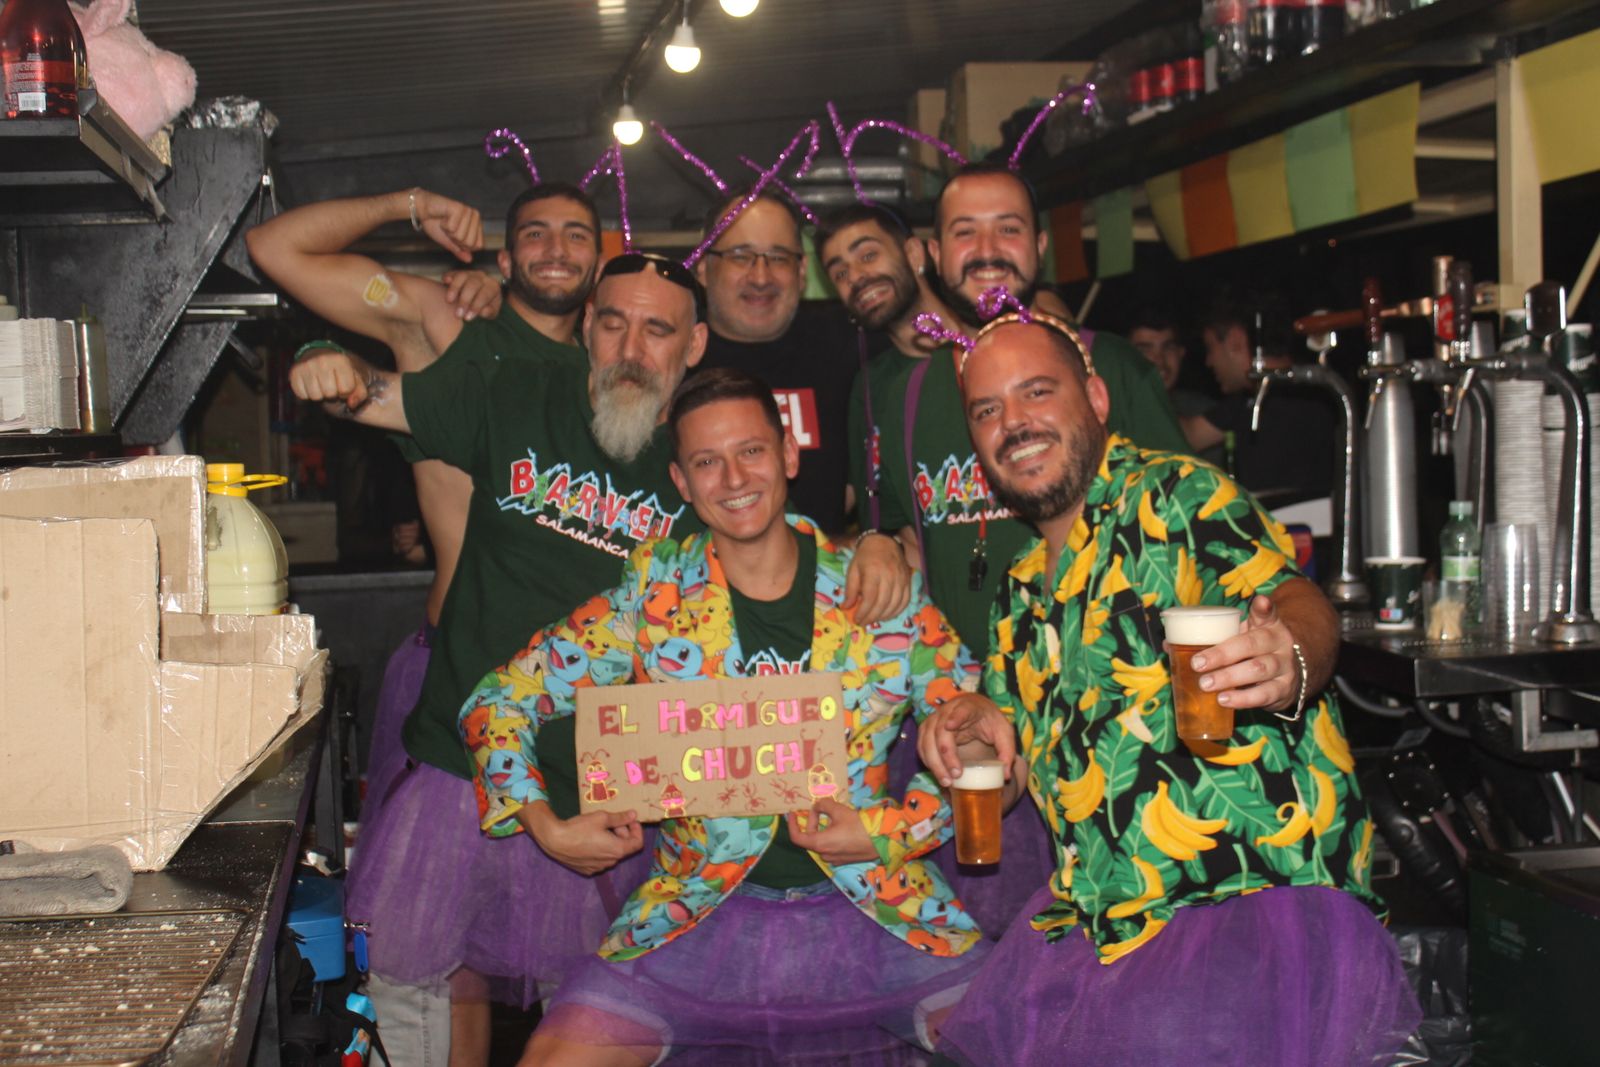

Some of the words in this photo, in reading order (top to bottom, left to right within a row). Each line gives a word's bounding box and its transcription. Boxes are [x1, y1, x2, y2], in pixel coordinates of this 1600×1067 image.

[535, 513, 629, 559] SALAMANCA
[598, 704, 639, 736] EL
[658, 696, 837, 735] HORMIGUEO
[624, 756, 661, 786] DE
[681, 739, 817, 782] CHUCHI
